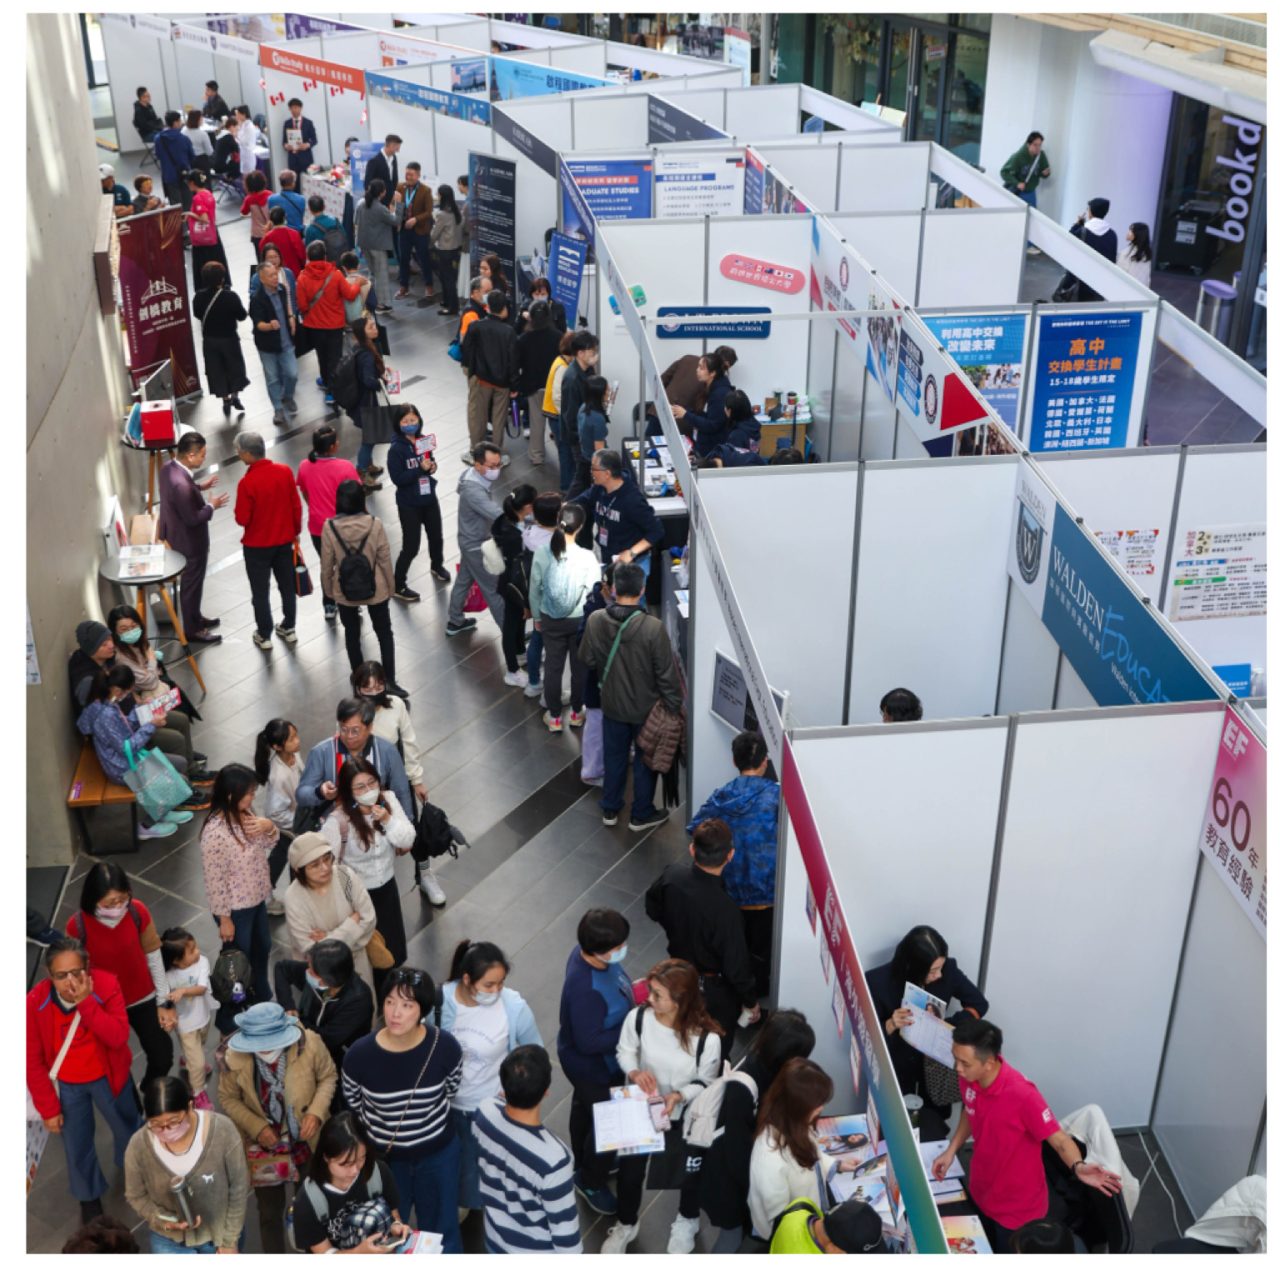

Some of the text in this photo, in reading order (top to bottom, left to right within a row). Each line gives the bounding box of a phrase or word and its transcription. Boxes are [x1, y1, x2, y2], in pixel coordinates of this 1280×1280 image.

[1205, 155, 1258, 244] book
[1069, 337, 1105, 356] 高中
[1053, 545, 1105, 632] WALDEN
[1222, 718, 1249, 758] EF
[1205, 823, 1254, 902] 教育經驗
